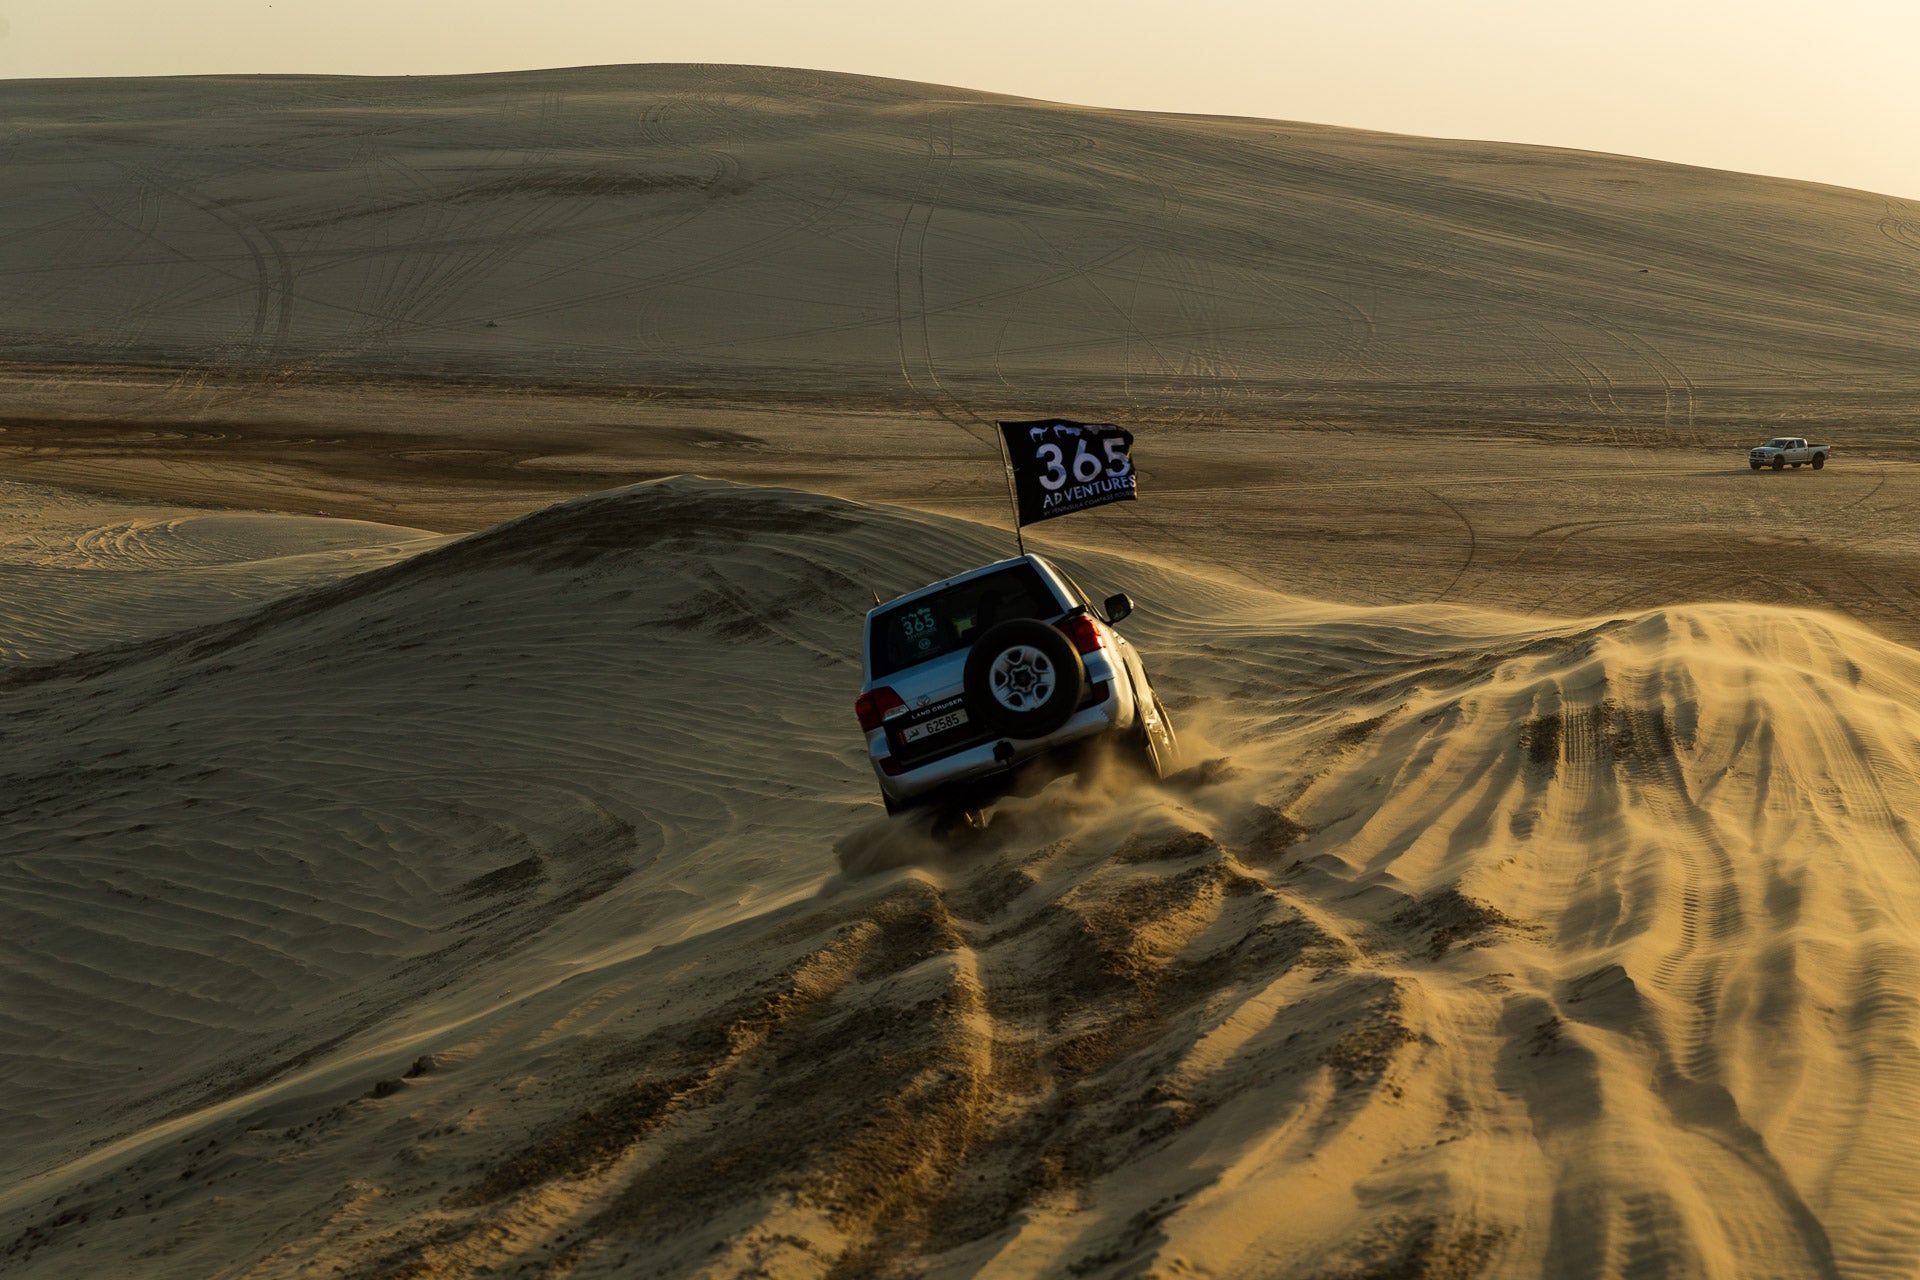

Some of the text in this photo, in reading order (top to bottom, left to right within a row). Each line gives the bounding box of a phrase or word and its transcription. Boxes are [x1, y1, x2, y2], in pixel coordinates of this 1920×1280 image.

[1036, 437, 1131, 490] 365
[1043, 475, 1136, 508] ADVENTURES
[903, 613, 935, 635] 365
[912, 697, 963, 719] LAND CRUISER
[926, 713, 960, 733] 62585
